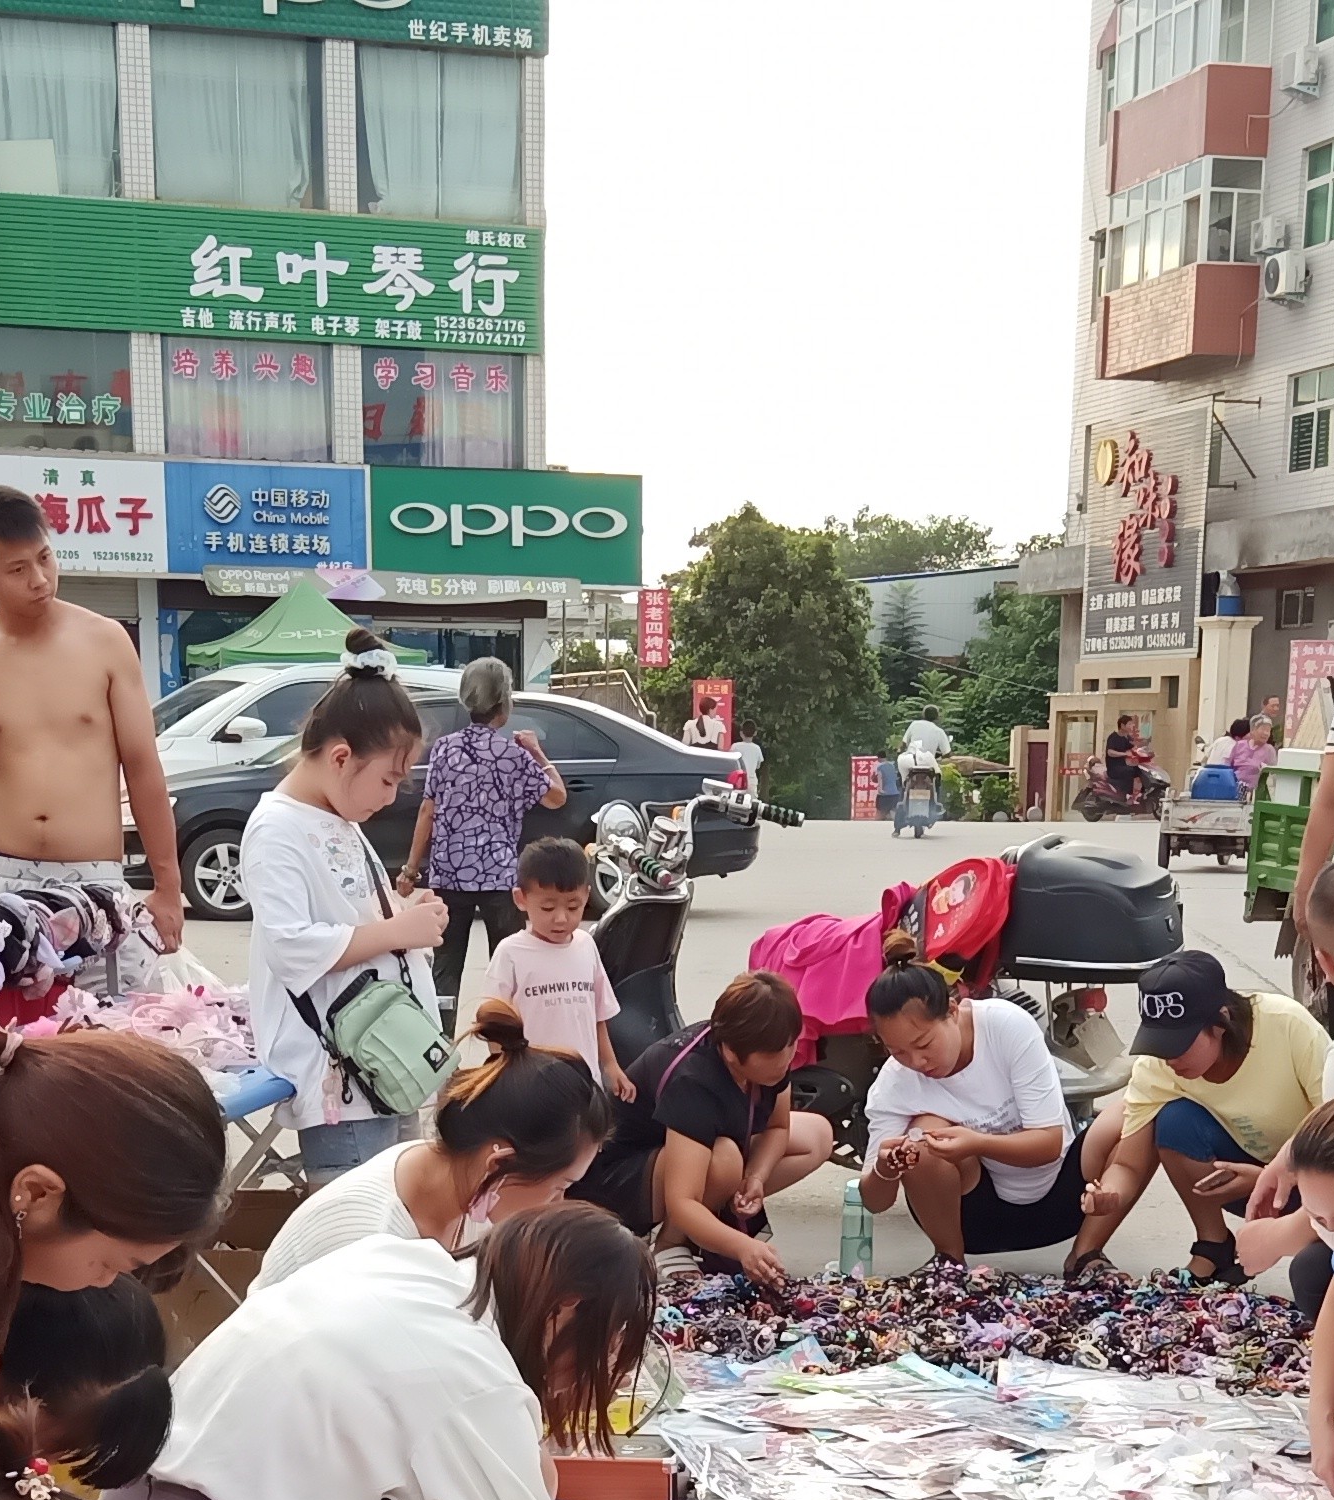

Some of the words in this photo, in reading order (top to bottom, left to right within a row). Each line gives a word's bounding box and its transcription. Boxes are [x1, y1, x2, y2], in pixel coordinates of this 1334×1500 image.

[408, 19, 533, 50] 世纪手机卖场
[190, 235, 520, 316] 红叶琴行
[180, 307, 214, 329] 吉他
[229, 309, 297, 334] 流行声乐
[312, 314, 360, 337] 电子琴
[375, 317, 422, 341] 架子鼓
[434, 315, 526, 333] 15236267176
[172, 348, 319, 386] 培养兴趣
[373, 357, 511, 393] 学习音乐
[43, 468, 96, 487] 清真
[251, 488, 330, 510] 中国移动
[253, 510, 287, 525] China
[290, 511, 330, 526] Mobile
[204, 531, 331, 556] 手机连锁卖场
[219, 569, 252, 582] OPPO
[395, 576, 478, 596] 充电5分钟
